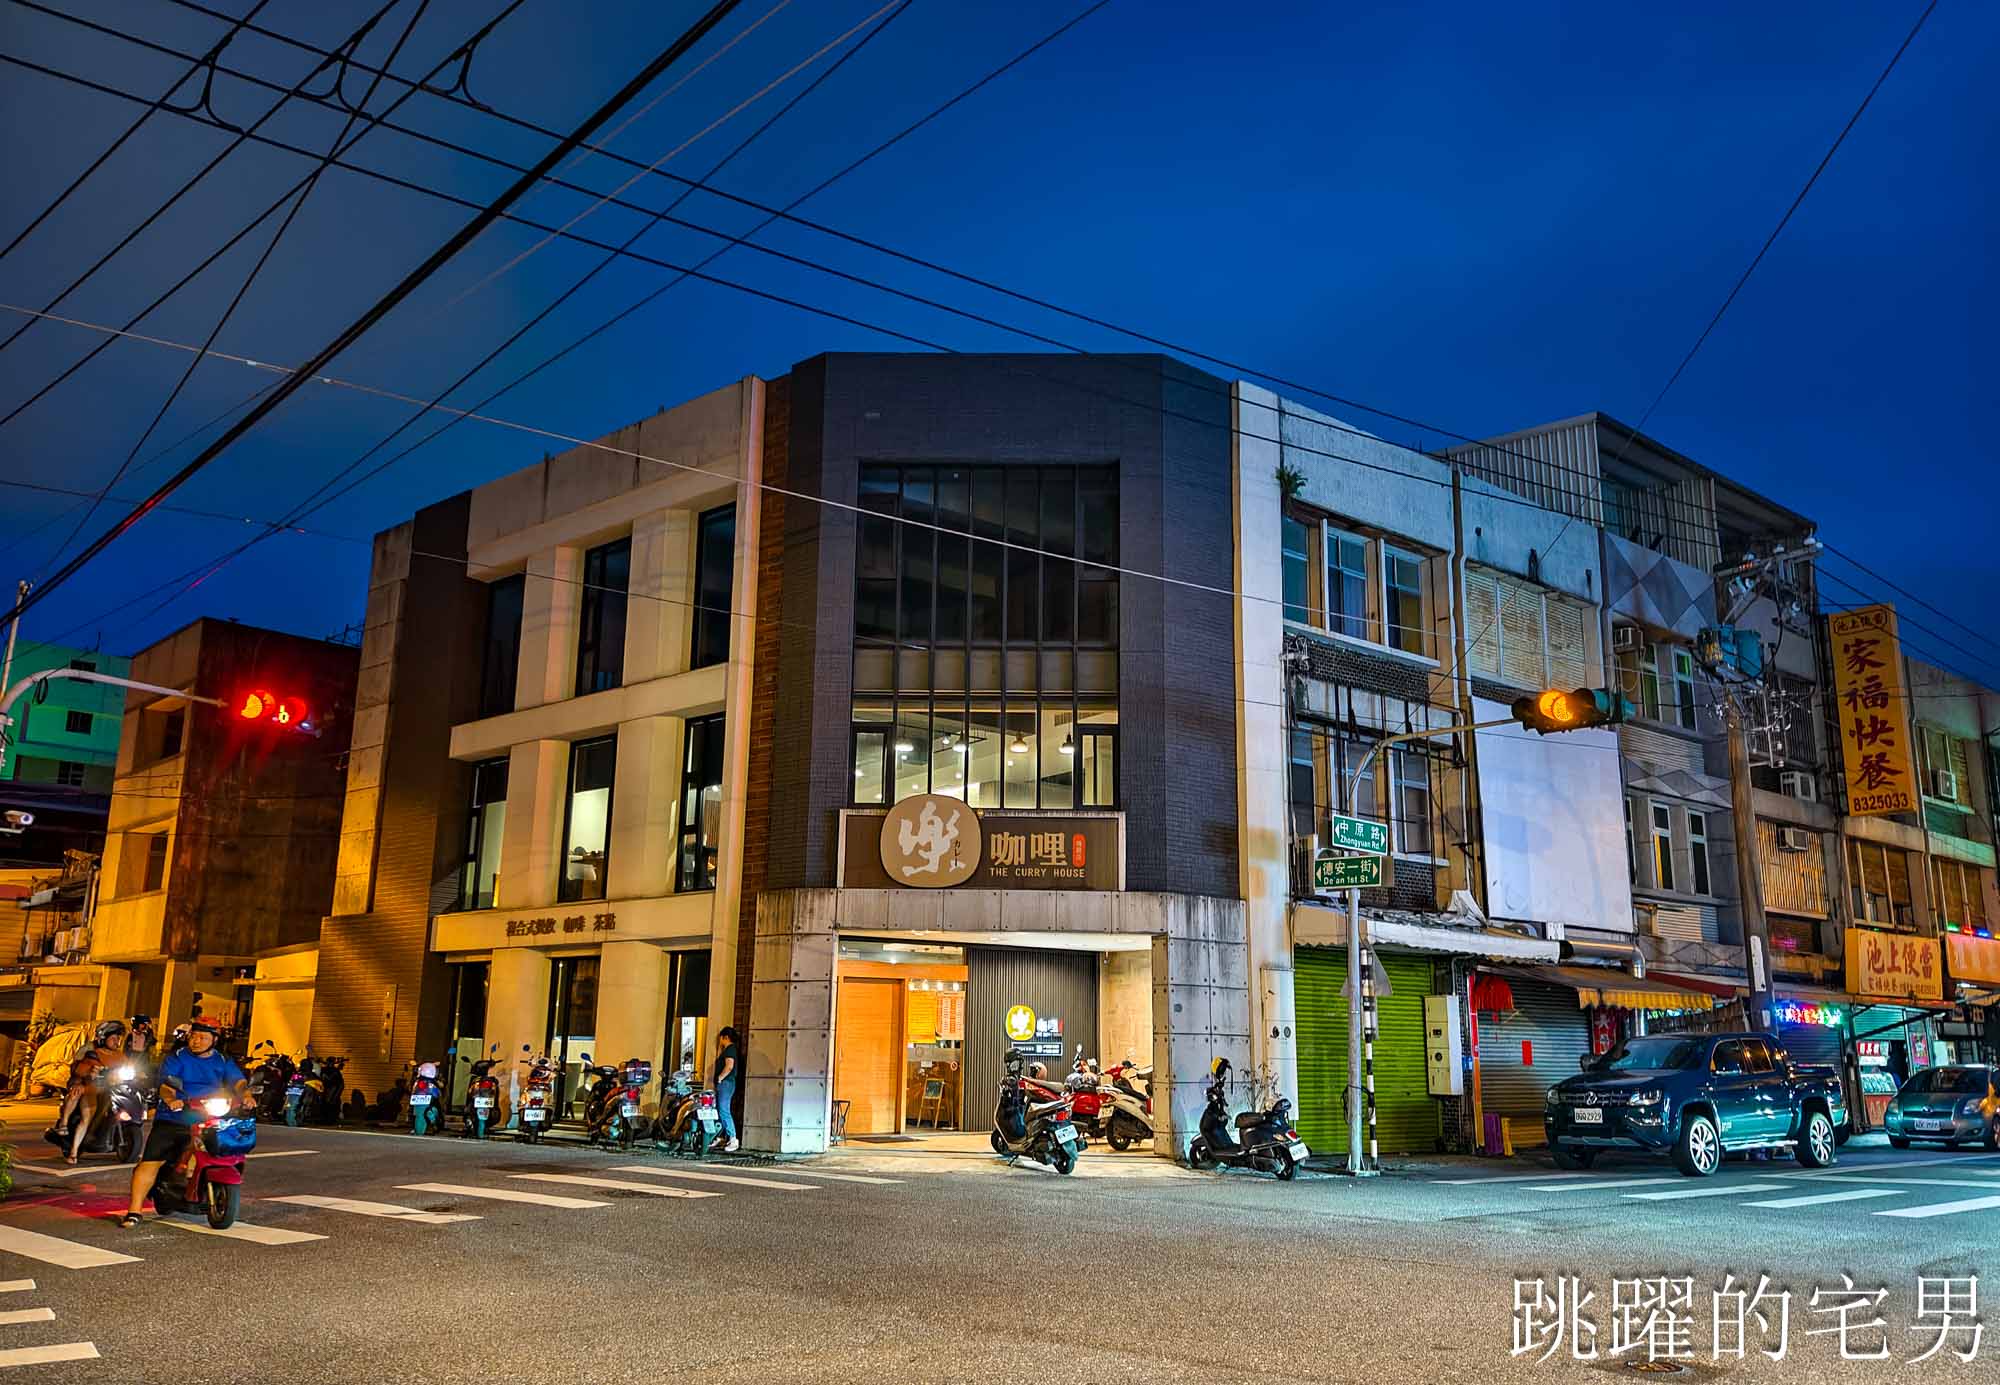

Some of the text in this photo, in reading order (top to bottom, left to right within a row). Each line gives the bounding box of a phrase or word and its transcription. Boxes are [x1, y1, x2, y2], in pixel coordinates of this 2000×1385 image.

[1841, 637, 1903, 791] 家福快餐
[1853, 792, 1909, 811] 8325033
[1340, 820, 1380, 840] 中原路
[990, 832, 1068, 866] 咖哩
[1340, 834, 1371, 848] Zhongyuan
[990, 868, 1085, 878] THE CURRY HOUSE
[1323, 859, 1371, 875] 德安一街
[1347, 875, 1358, 883] 1st
[1360, 875, 1368, 883] St
[1866, 936, 1933, 980] 池上便當
